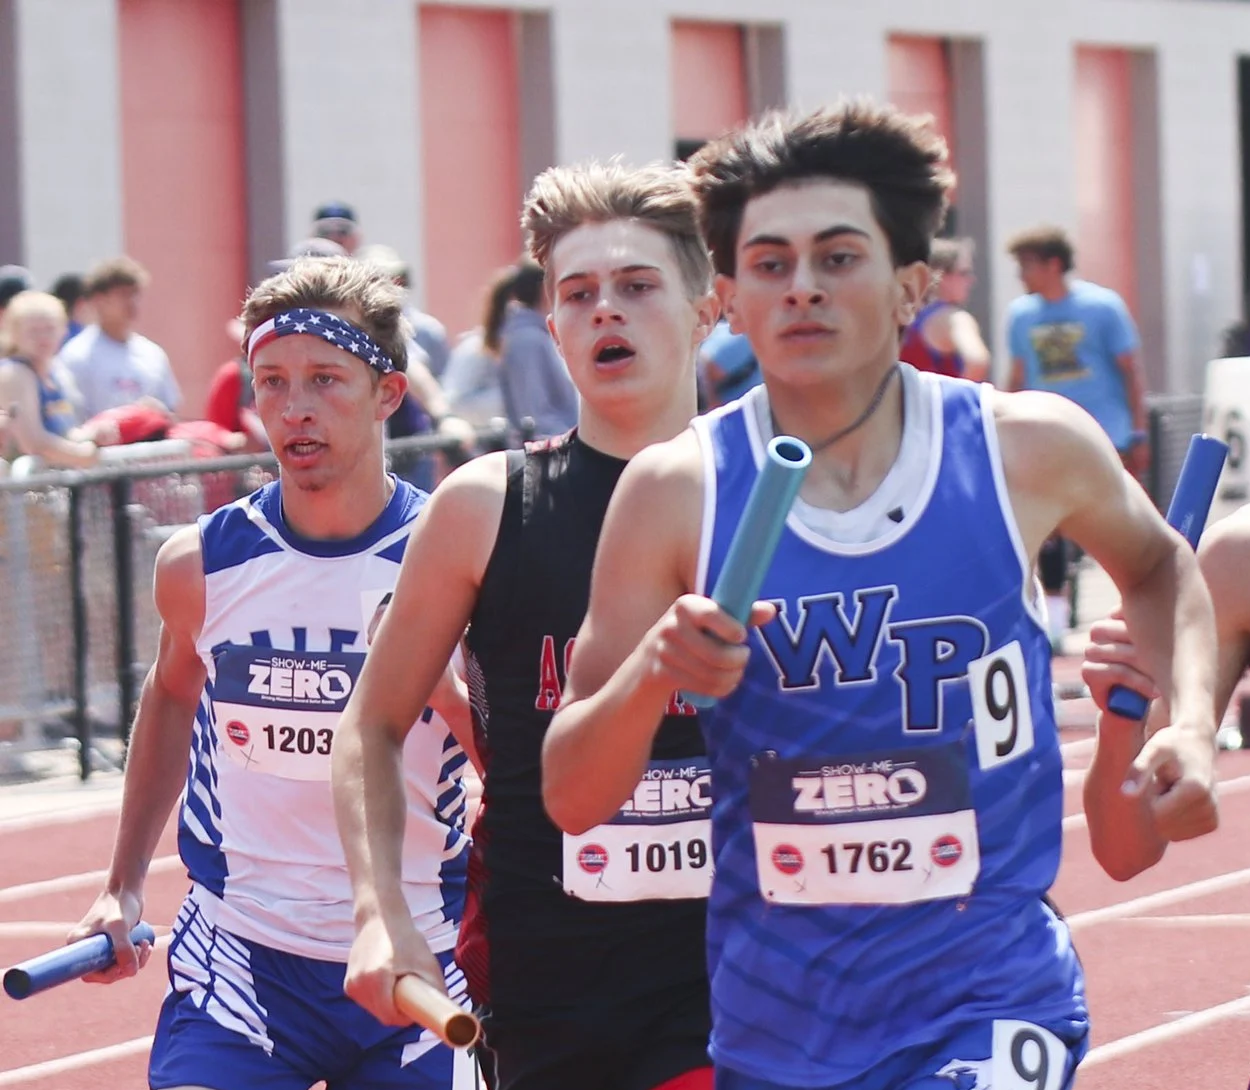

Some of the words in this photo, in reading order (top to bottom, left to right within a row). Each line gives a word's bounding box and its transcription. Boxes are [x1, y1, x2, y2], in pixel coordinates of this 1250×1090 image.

[271, 657, 327, 671] SHOW-ME
[248, 664, 351, 700] ZERO
[985, 656, 1018, 757] 9
[263, 724, 334, 755] 1203
[821, 760, 893, 776] SHOW-ME
[791, 768, 926, 812] ZERO
[625, 839, 707, 873] 1019
[820, 838, 913, 874] 1762
